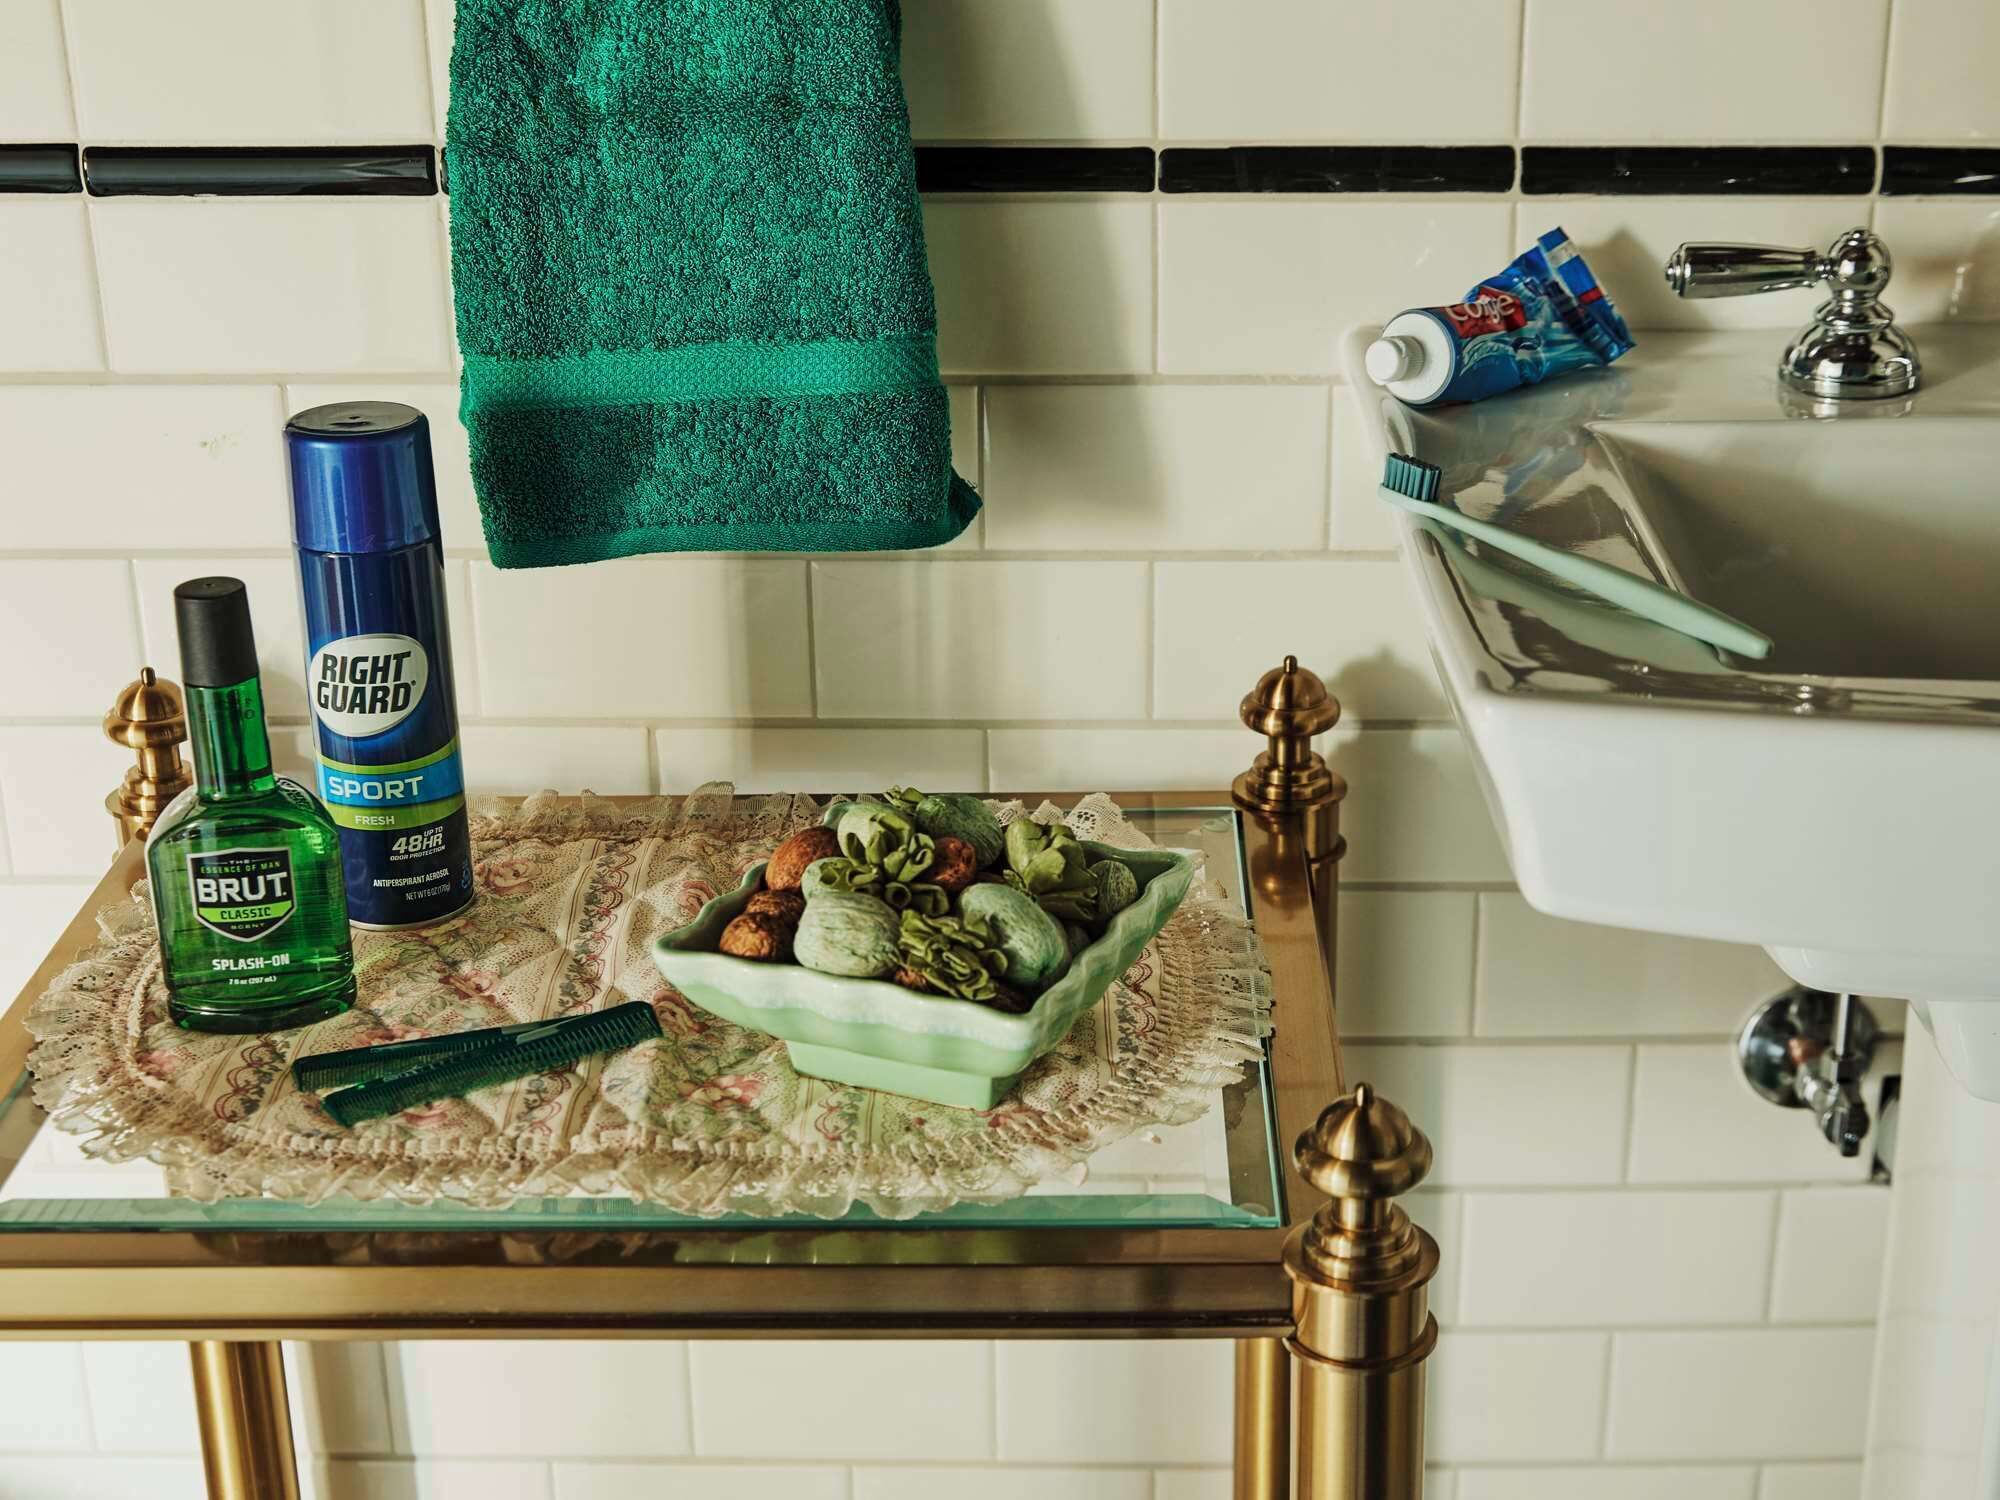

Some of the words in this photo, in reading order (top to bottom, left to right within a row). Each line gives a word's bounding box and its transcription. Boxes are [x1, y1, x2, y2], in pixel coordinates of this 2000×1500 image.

[322, 650, 411, 683] RIGHT
[317, 682, 413, 714] GUARD
[328, 775, 424, 800] SPORT
[355, 814, 395, 826] FRESH
[409, 845, 445, 859] PROTECTION
[200, 865, 241, 874] ESSENCE
[245, 864, 257, 872] OF
[260, 861, 281, 870] MAN
[373, 874, 425, 888] ANTIPERSPIRANT
[425, 868, 450, 882] AEROSOL
[405, 891, 417, 900] NET
[417, 889, 427, 898] WT
[220, 907, 272, 920] CLASSIC
[230, 922, 265, 930] SCENT
[212, 952, 290, 971] SPLASH-ON
